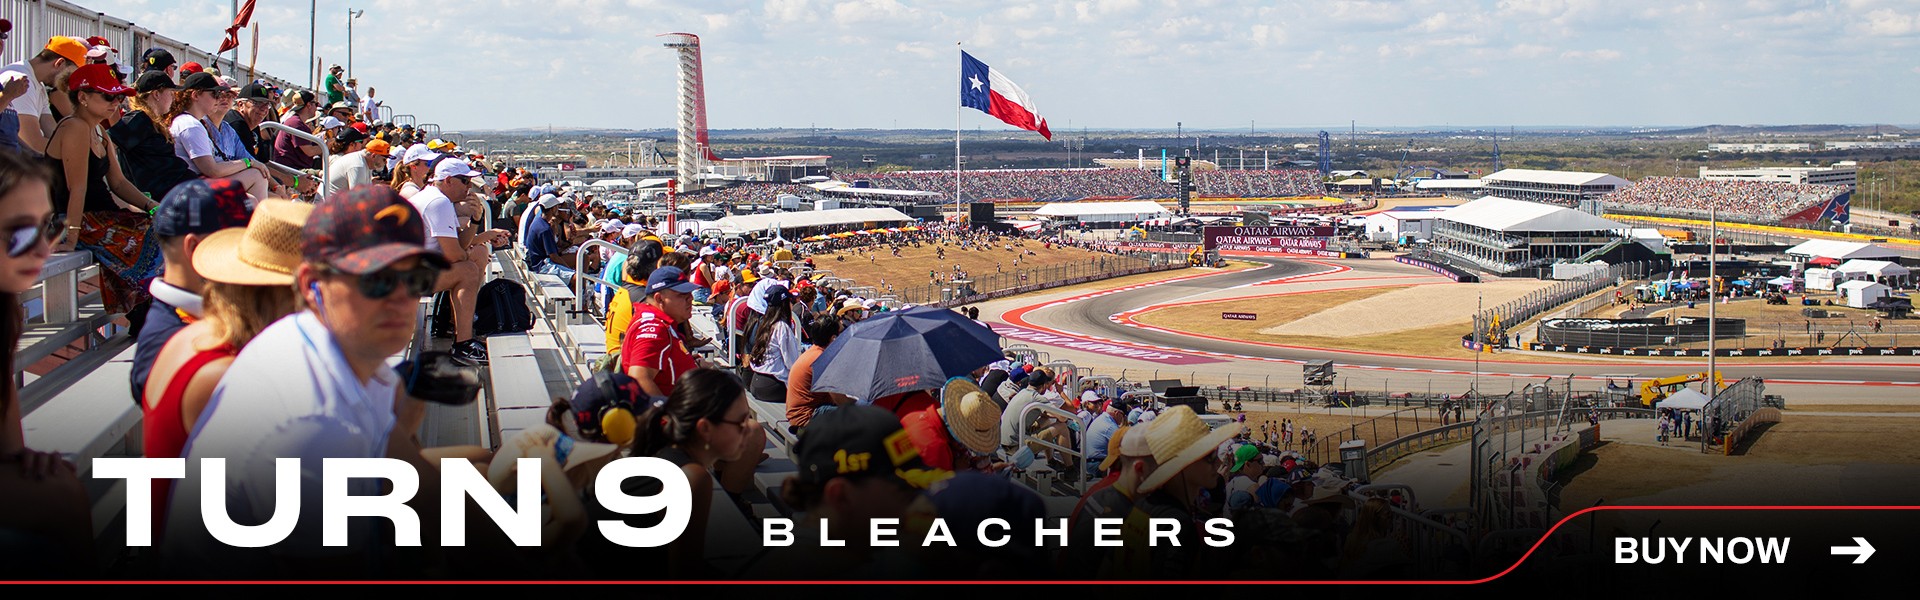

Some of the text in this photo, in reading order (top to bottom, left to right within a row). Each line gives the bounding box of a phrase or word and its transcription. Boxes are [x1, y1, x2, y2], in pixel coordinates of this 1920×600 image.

[1234, 227, 1315, 236] QATAR AIRWAYS
[1216, 236, 1271, 245] QATAR AIRWAYS
[1280, 238, 1322, 249] QATAR AIRWAYS
[833, 448, 872, 474] 1ST
